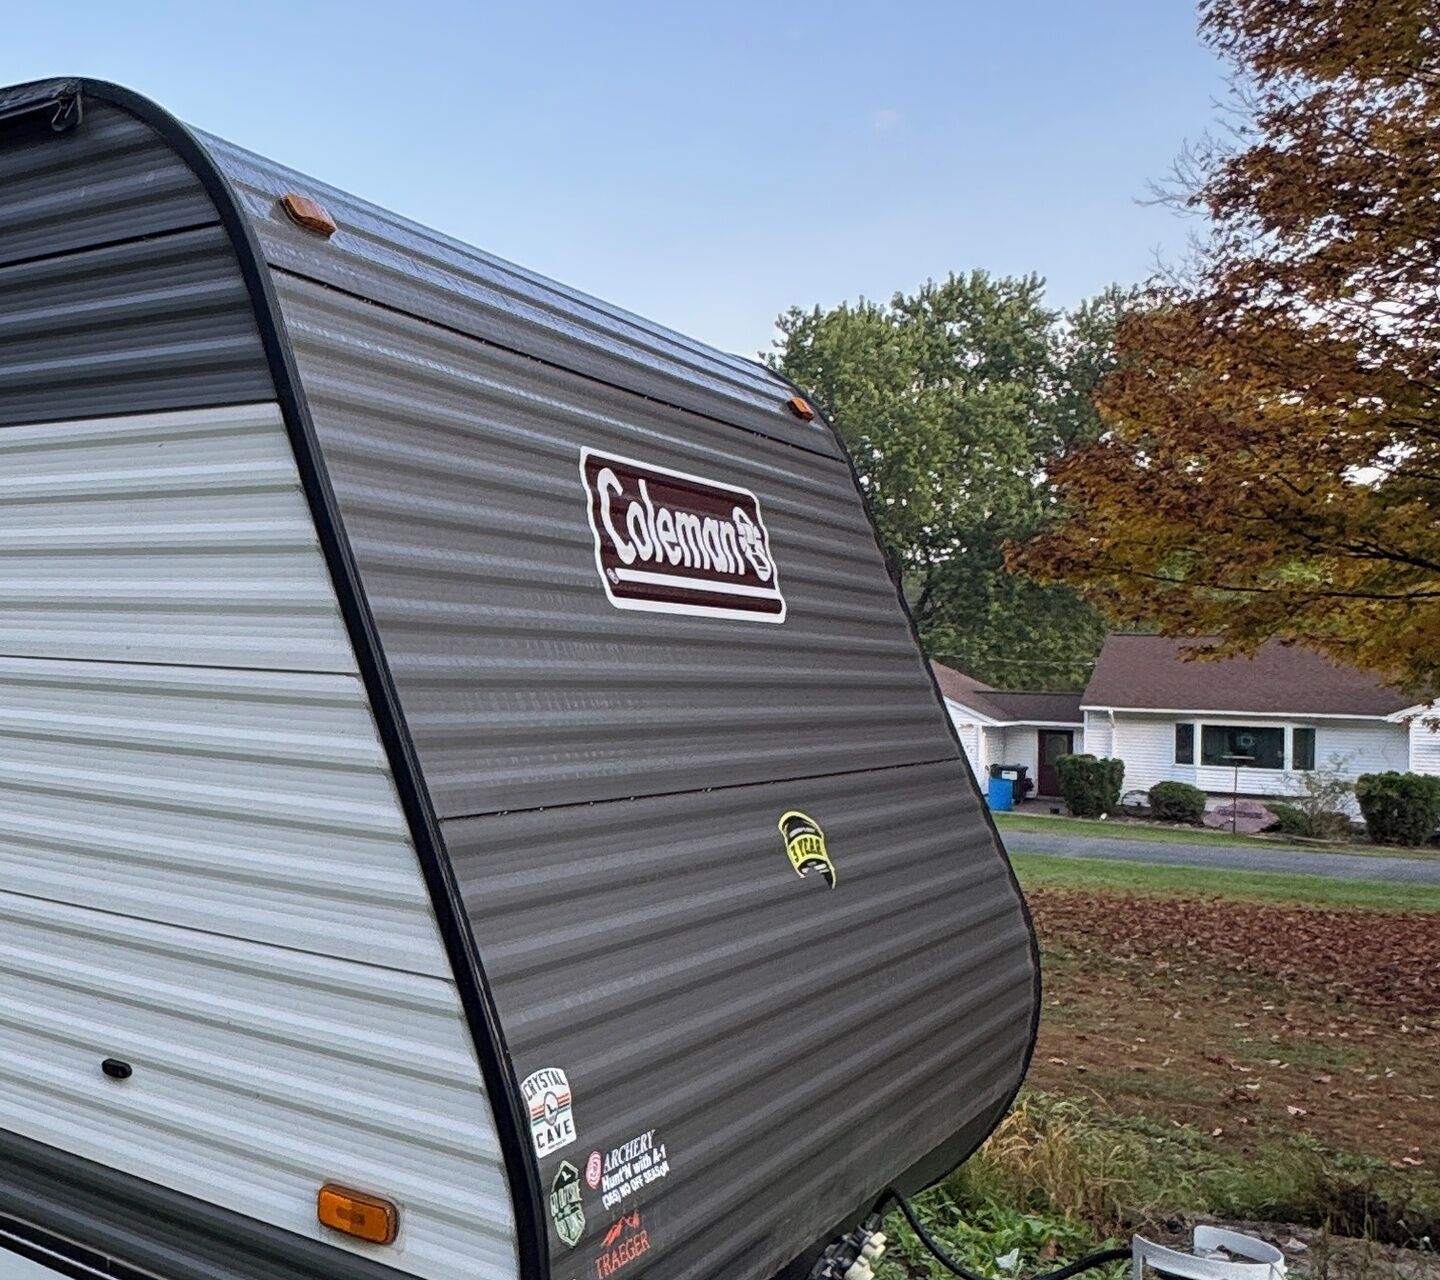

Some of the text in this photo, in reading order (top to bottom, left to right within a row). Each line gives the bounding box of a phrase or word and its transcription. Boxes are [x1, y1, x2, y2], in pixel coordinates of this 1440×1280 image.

[597, 467, 746, 576] Coleman
[523, 1070, 567, 1101] CRYSTAL
[536, 1119, 572, 1149] CAVE
[604, 1129, 656, 1174] ARCHERY
[632, 1153, 652, 1174] with
[619, 1182, 632, 1197] NO
[630, 1174, 644, 1191] OFF
[594, 1230, 651, 1280] TRAEGER
